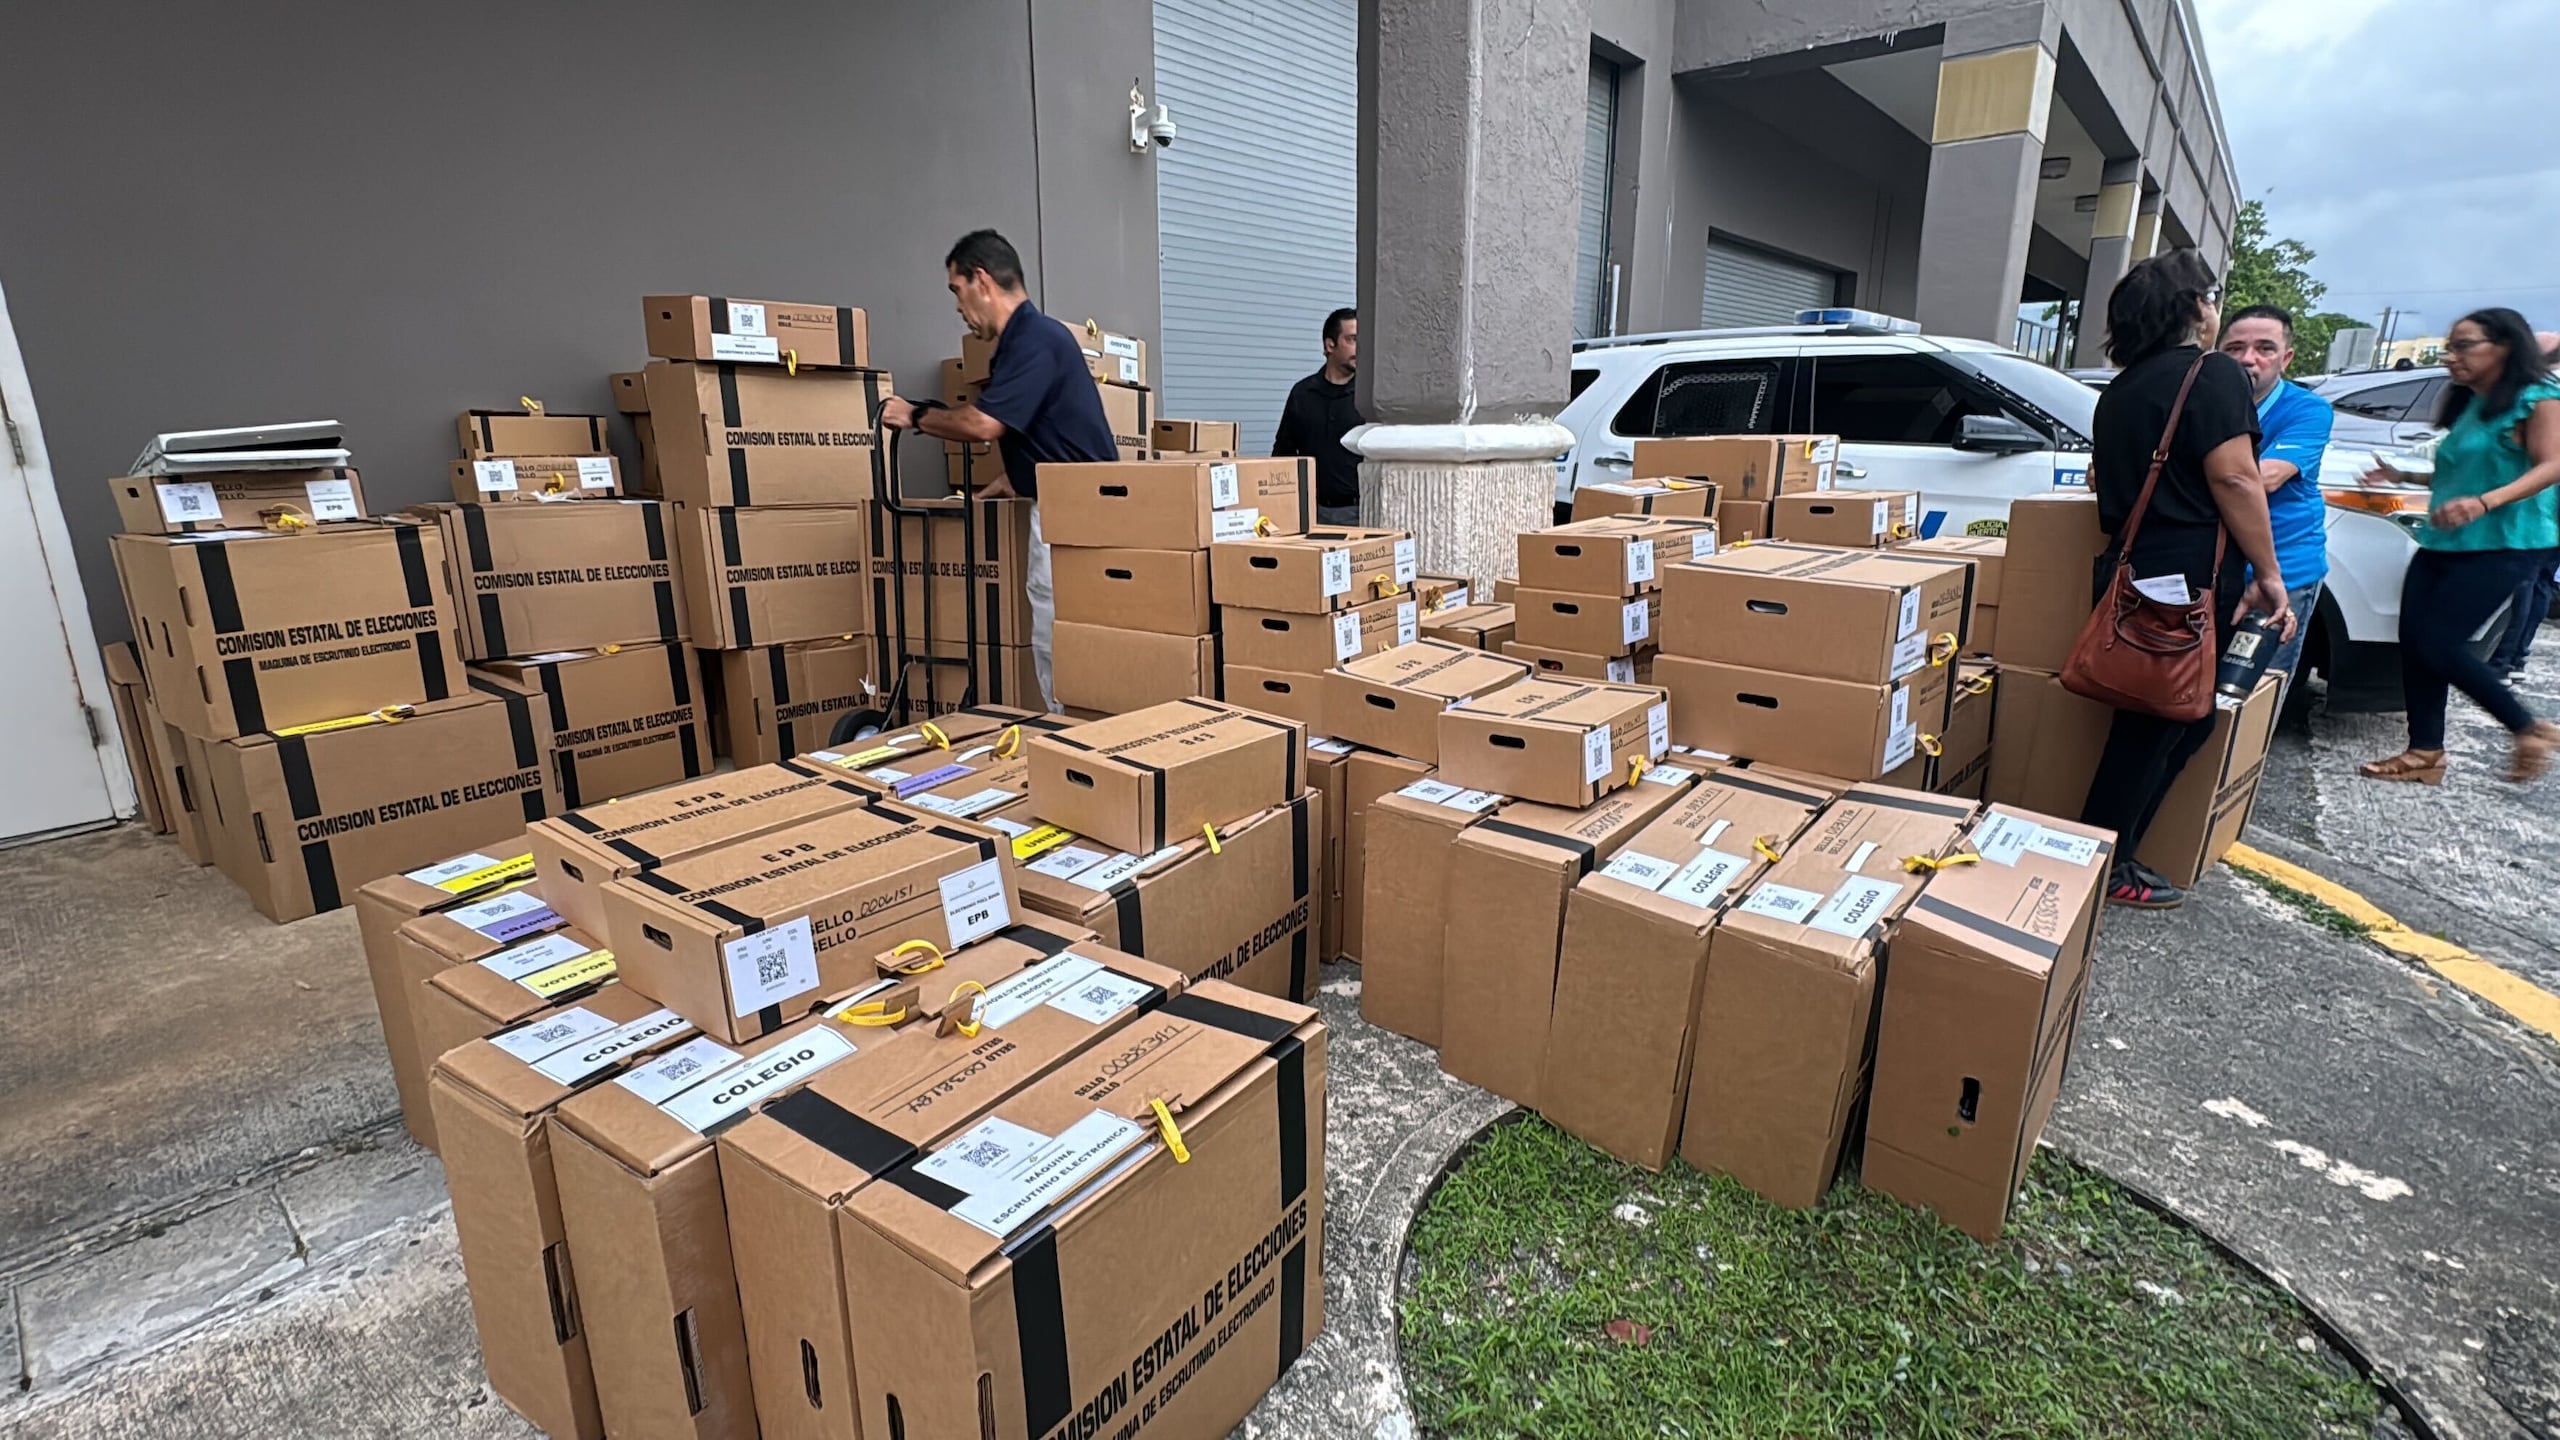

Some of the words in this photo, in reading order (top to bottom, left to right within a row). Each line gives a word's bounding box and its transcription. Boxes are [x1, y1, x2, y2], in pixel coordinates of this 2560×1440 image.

[726, 431, 775, 446] COMISION
[778, 432, 816, 446] ESTATAL
[818, 433, 830, 446] DE
[833, 432, 874, 446] ELECCION
[1116, 435, 1147, 448] ELECCIONES
[216, 483, 243, 492] ELLO
[218, 492, 245, 500] ELLO
[326, 504, 343, 512] EPB
[1969, 521, 2004, 531] POLICIA
[474, 570, 534, 590] COMISION
[537, 567, 584, 585] ESTATAL
[587, 566, 602, 581] DE
[605, 563, 669, 580] ELECCIONES
[727, 567, 774, 584] COMISION
[778, 563, 815, 579] ESTATAL
[816, 562, 828, 576] DE
[872, 560, 907, 575] COMISN
[909, 561, 939, 576] ESTAL
[940, 562, 951, 577] DE
[953, 563, 999, 579] ELEIONES
[216, 631, 286, 656] COMISION
[289, 623, 344, 646] ESTATAL
[345, 619, 363, 638] DE
[366, 610, 437, 634] ELECCIONES
[258, 656, 299, 671] MAQUINA
[300, 653, 312, 666] DE
[313, 646, 360, 664] ESCRUTINIO
[361, 639, 411, 658] ELECTRONICO
[776, 701, 819, 722] COMISION
[822, 694, 857, 712] ESTATAL
[916, 699, 945, 714] ESTAL
[597, 720, 632, 740] ESTATAL
[634, 717, 645, 731] DE
[647, 707, 693, 730] ELECCIONES
[1180, 732, 1216, 746] EPB
[297, 811, 374, 842] COMISION
[379, 798, 437, 824] ESTATAL
[441, 791, 460, 808] DE
[464, 770, 542, 803] ELECCIONES
[593, 815, 668, 842] COMISION
[671, 803, 730, 825] ESTATAL
[732, 796, 749, 809] DE
[750, 777, 827, 802] ELECCIONES
[1023, 829, 1063, 848] UNIDA
[473, 857, 535, 882] UNIDA
[678, 874, 760, 904] COMISION
[764, 859, 824, 880] ESTATAL
[827, 851, 846, 866] DE
[848, 824, 926, 853] ELECCIONES
[1691, 862, 1729, 894] COLEGIO
[860, 884, 913, 917] 0006151
[1843, 889, 1880, 924] COLEGIO
[967, 909, 990, 926] EPB
[1236, 945, 1250, 967] DE
[1252, 901, 1309, 957] ELECCIONES
[539, 972, 578, 989] VOTO
[581, 961, 609, 973] POR
[1026, 957, 1074, 987] ESCRUTINIO
[583, 1017, 686, 1064] COLEGIO
[972, 1036, 1004, 1056] SELLO
[987, 1042, 1017, 1062] SELLO
[712, 1049, 816, 1105] COLEGIO
[906, 1059, 987, 1114] 0038184
[1074, 1076, 1106, 1097] SELLO
[1089, 1081, 1121, 1102] SELLO
[992, 1174, 1060, 1225] ESCRUTINIO
[1060, 1125, 1129, 1177] ELECTRÓNICO
[1024, 1148, 1076, 1185] MÁQUINA
[1047, 1370, 1127, 1440] MISION
[1132, 1303, 1200, 1396] ESTATAL
[1203, 1280, 1224, 1327] DE
[1228, 1200, 1307, 1303] ELECCIONES
[1143, 1395, 1157, 1426] DE
[1158, 1337, 1216, 1411] ESCRUTINIO
[1217, 1276, 1276, 1351] ELECTRONICO
